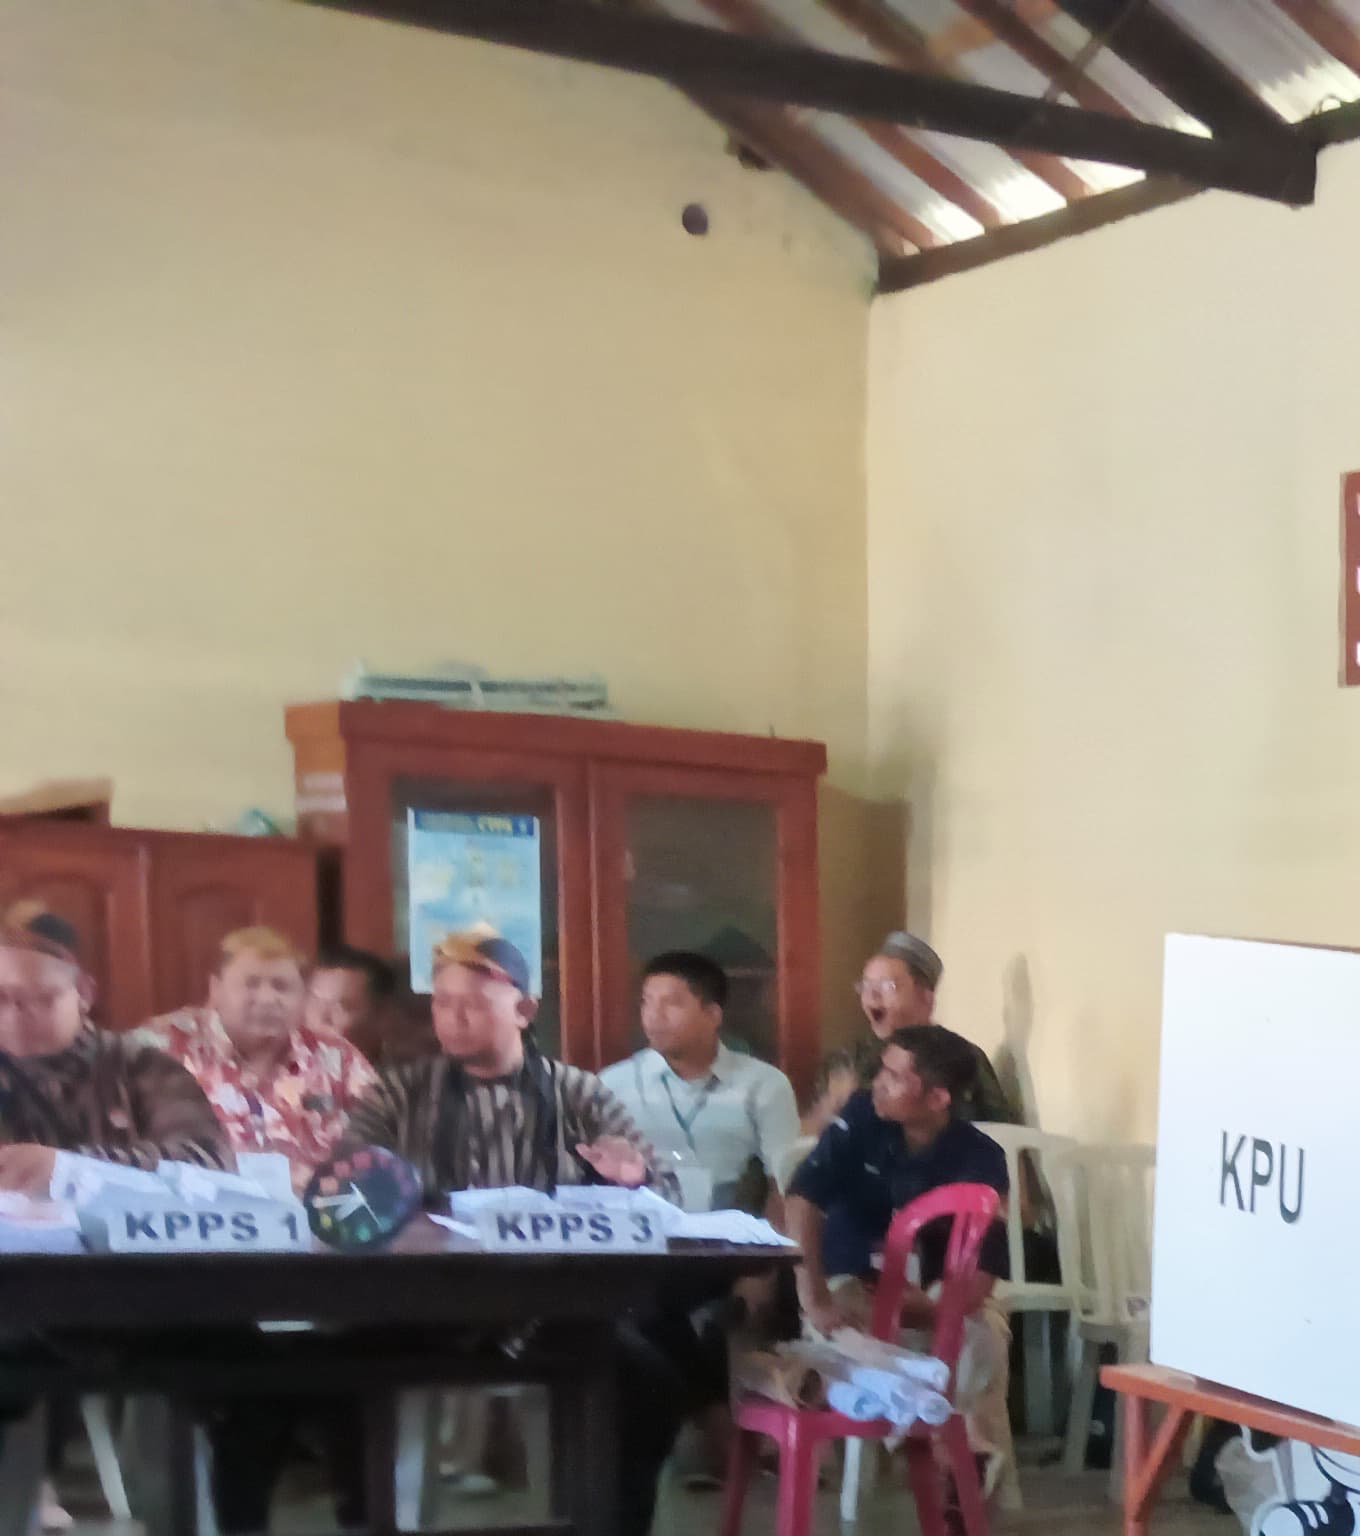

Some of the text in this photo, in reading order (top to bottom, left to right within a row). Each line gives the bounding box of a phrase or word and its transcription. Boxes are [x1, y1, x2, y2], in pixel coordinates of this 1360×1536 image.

[1219, 1130, 1304, 1224] KPU
[125, 1211, 299, 1241] KPPS 1
[496, 1211, 653, 1243] KPPS 3
